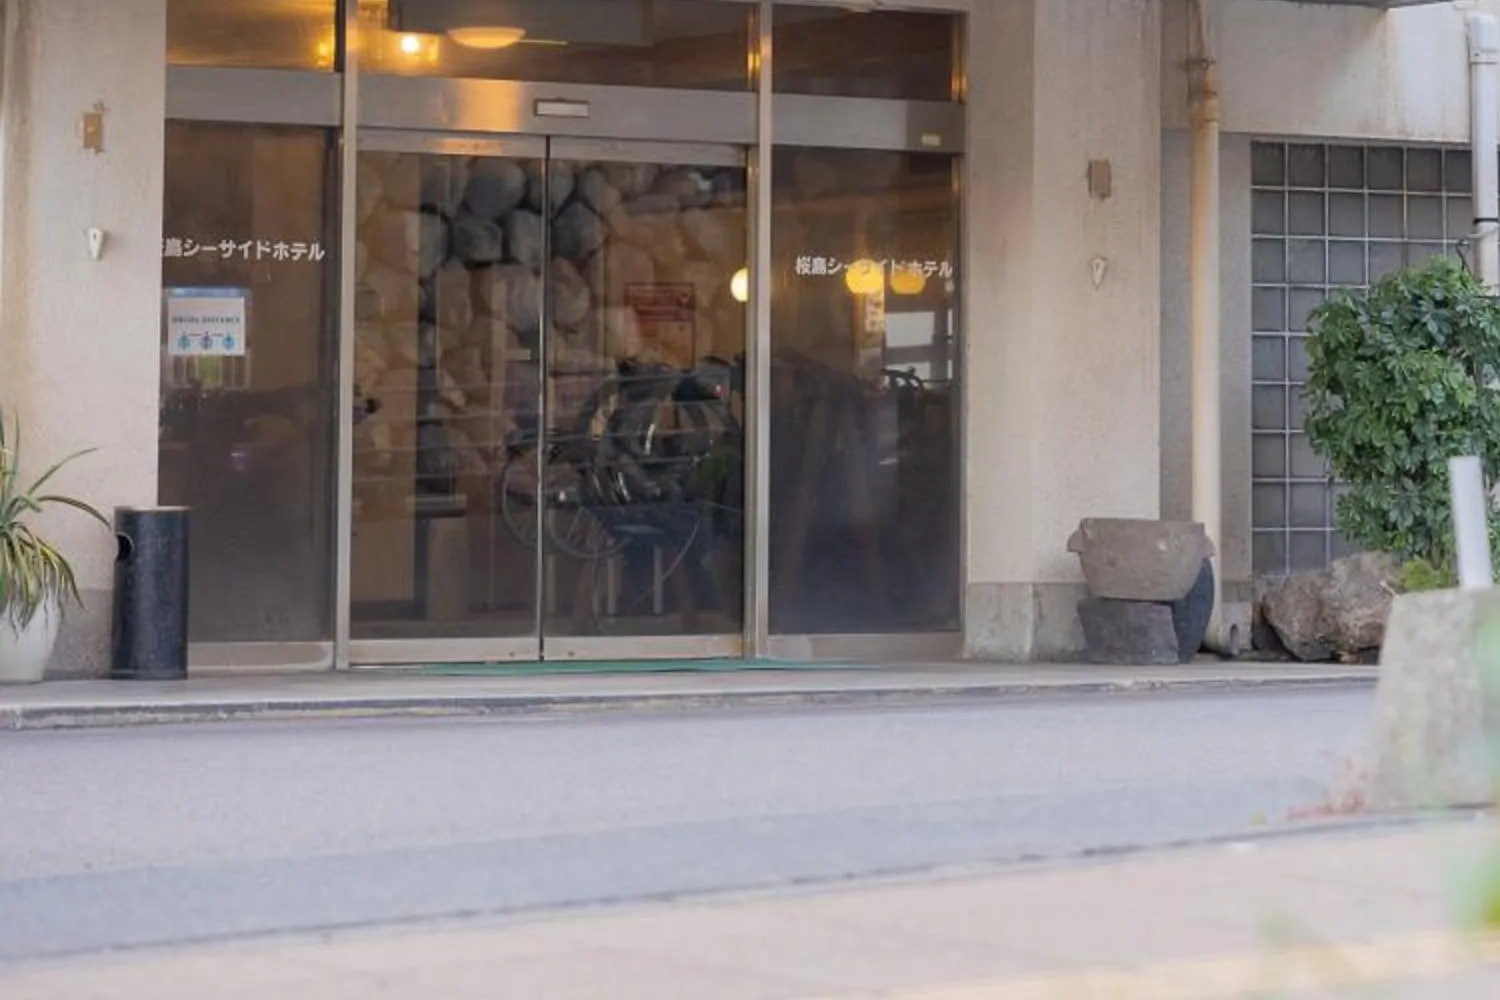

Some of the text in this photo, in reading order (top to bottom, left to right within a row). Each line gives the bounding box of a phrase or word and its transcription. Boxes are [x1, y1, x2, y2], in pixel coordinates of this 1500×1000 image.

[161, 237, 325, 261] 島シーサイドホテル
[795, 255, 953, 278] 桜島シドホテル
